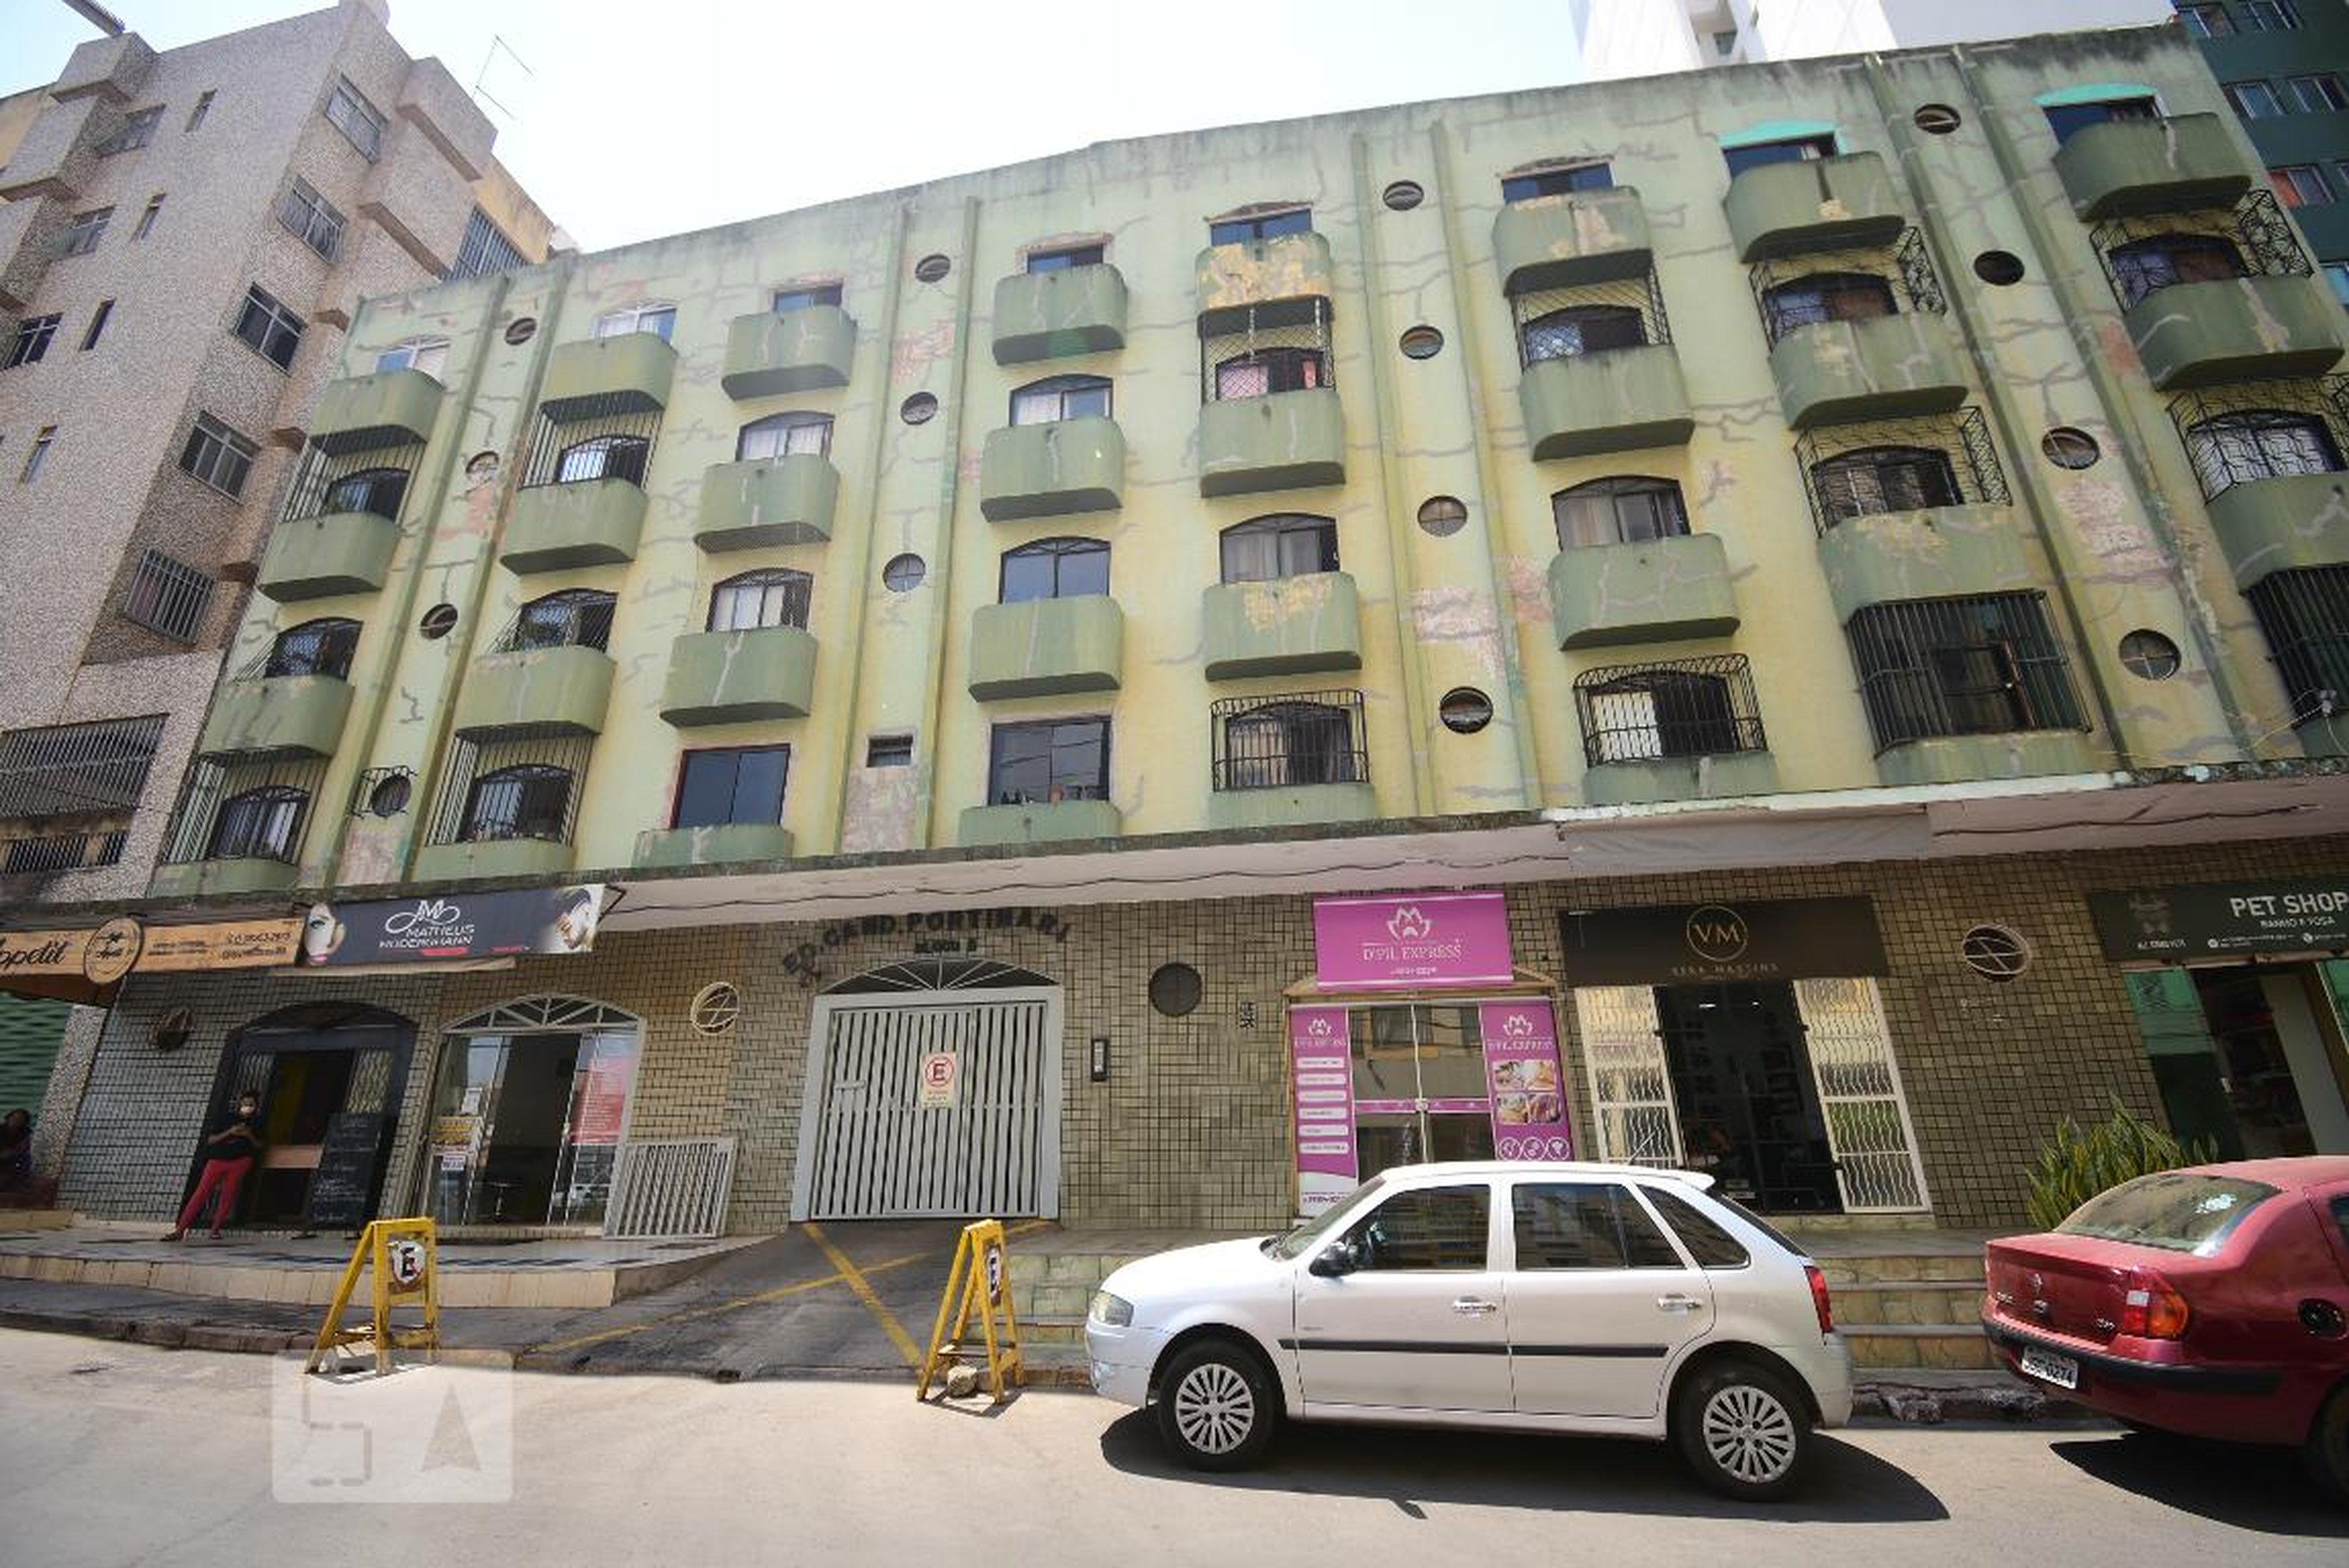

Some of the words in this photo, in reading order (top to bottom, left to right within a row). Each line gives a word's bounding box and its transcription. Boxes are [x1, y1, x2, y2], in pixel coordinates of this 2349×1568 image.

[2230, 897, 2276, 917] PET
[2283, 891, 2349, 914] SHOP
[1691, 923, 1741, 944] VM
[0, 937, 68, 970] ppetit
[1402, 944, 1462, 961] EXPRESS
